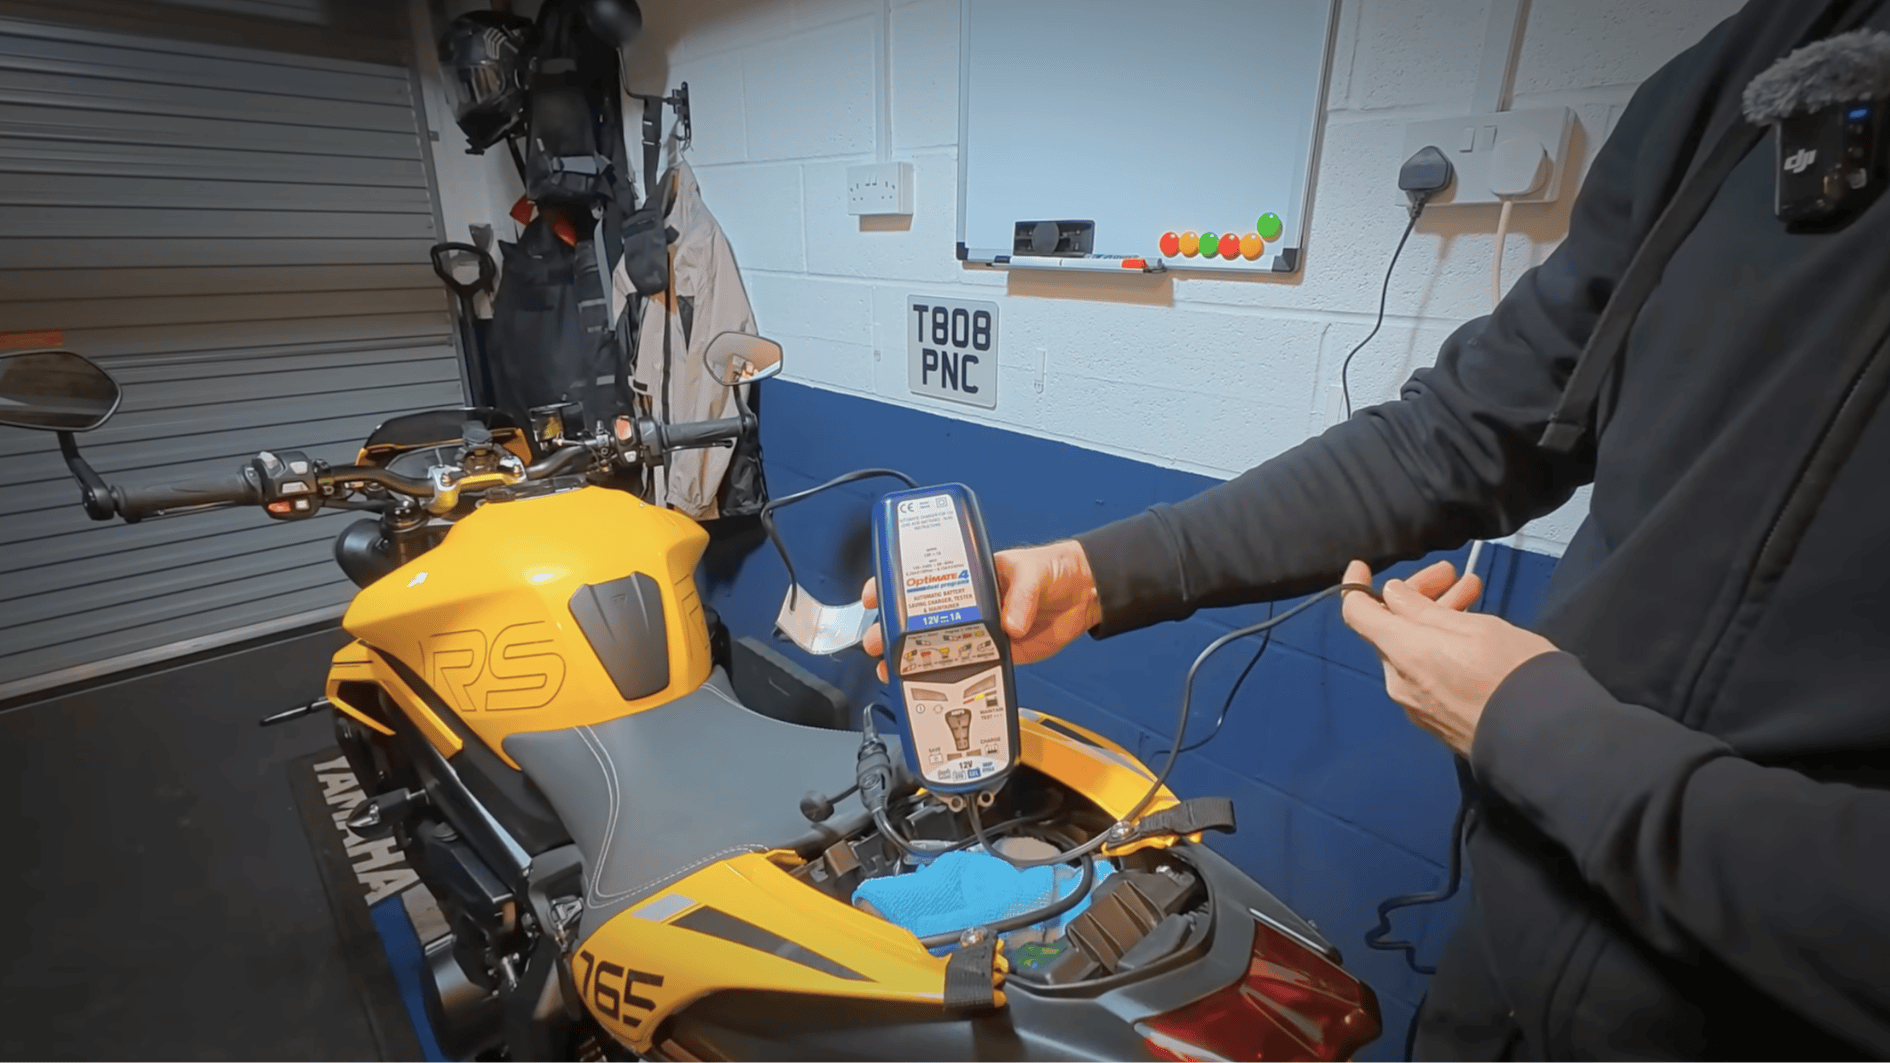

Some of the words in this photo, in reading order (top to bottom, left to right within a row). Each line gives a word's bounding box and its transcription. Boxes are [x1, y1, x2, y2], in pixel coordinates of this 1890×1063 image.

[913, 304, 991, 351] T808
[922, 348, 979, 394] PNC
[900, 502, 914, 513] CE
[958, 569, 969, 579] 4
[914, 592, 942, 601] AUTOMATIC
[943, 588, 965, 596] BATTERY
[954, 593, 973, 601] TESTER
[923, 615, 940, 626] 12V
[950, 611, 962, 621] 1A
[959, 760, 973, 769] 12V
[580, 950, 665, 1028] 765
